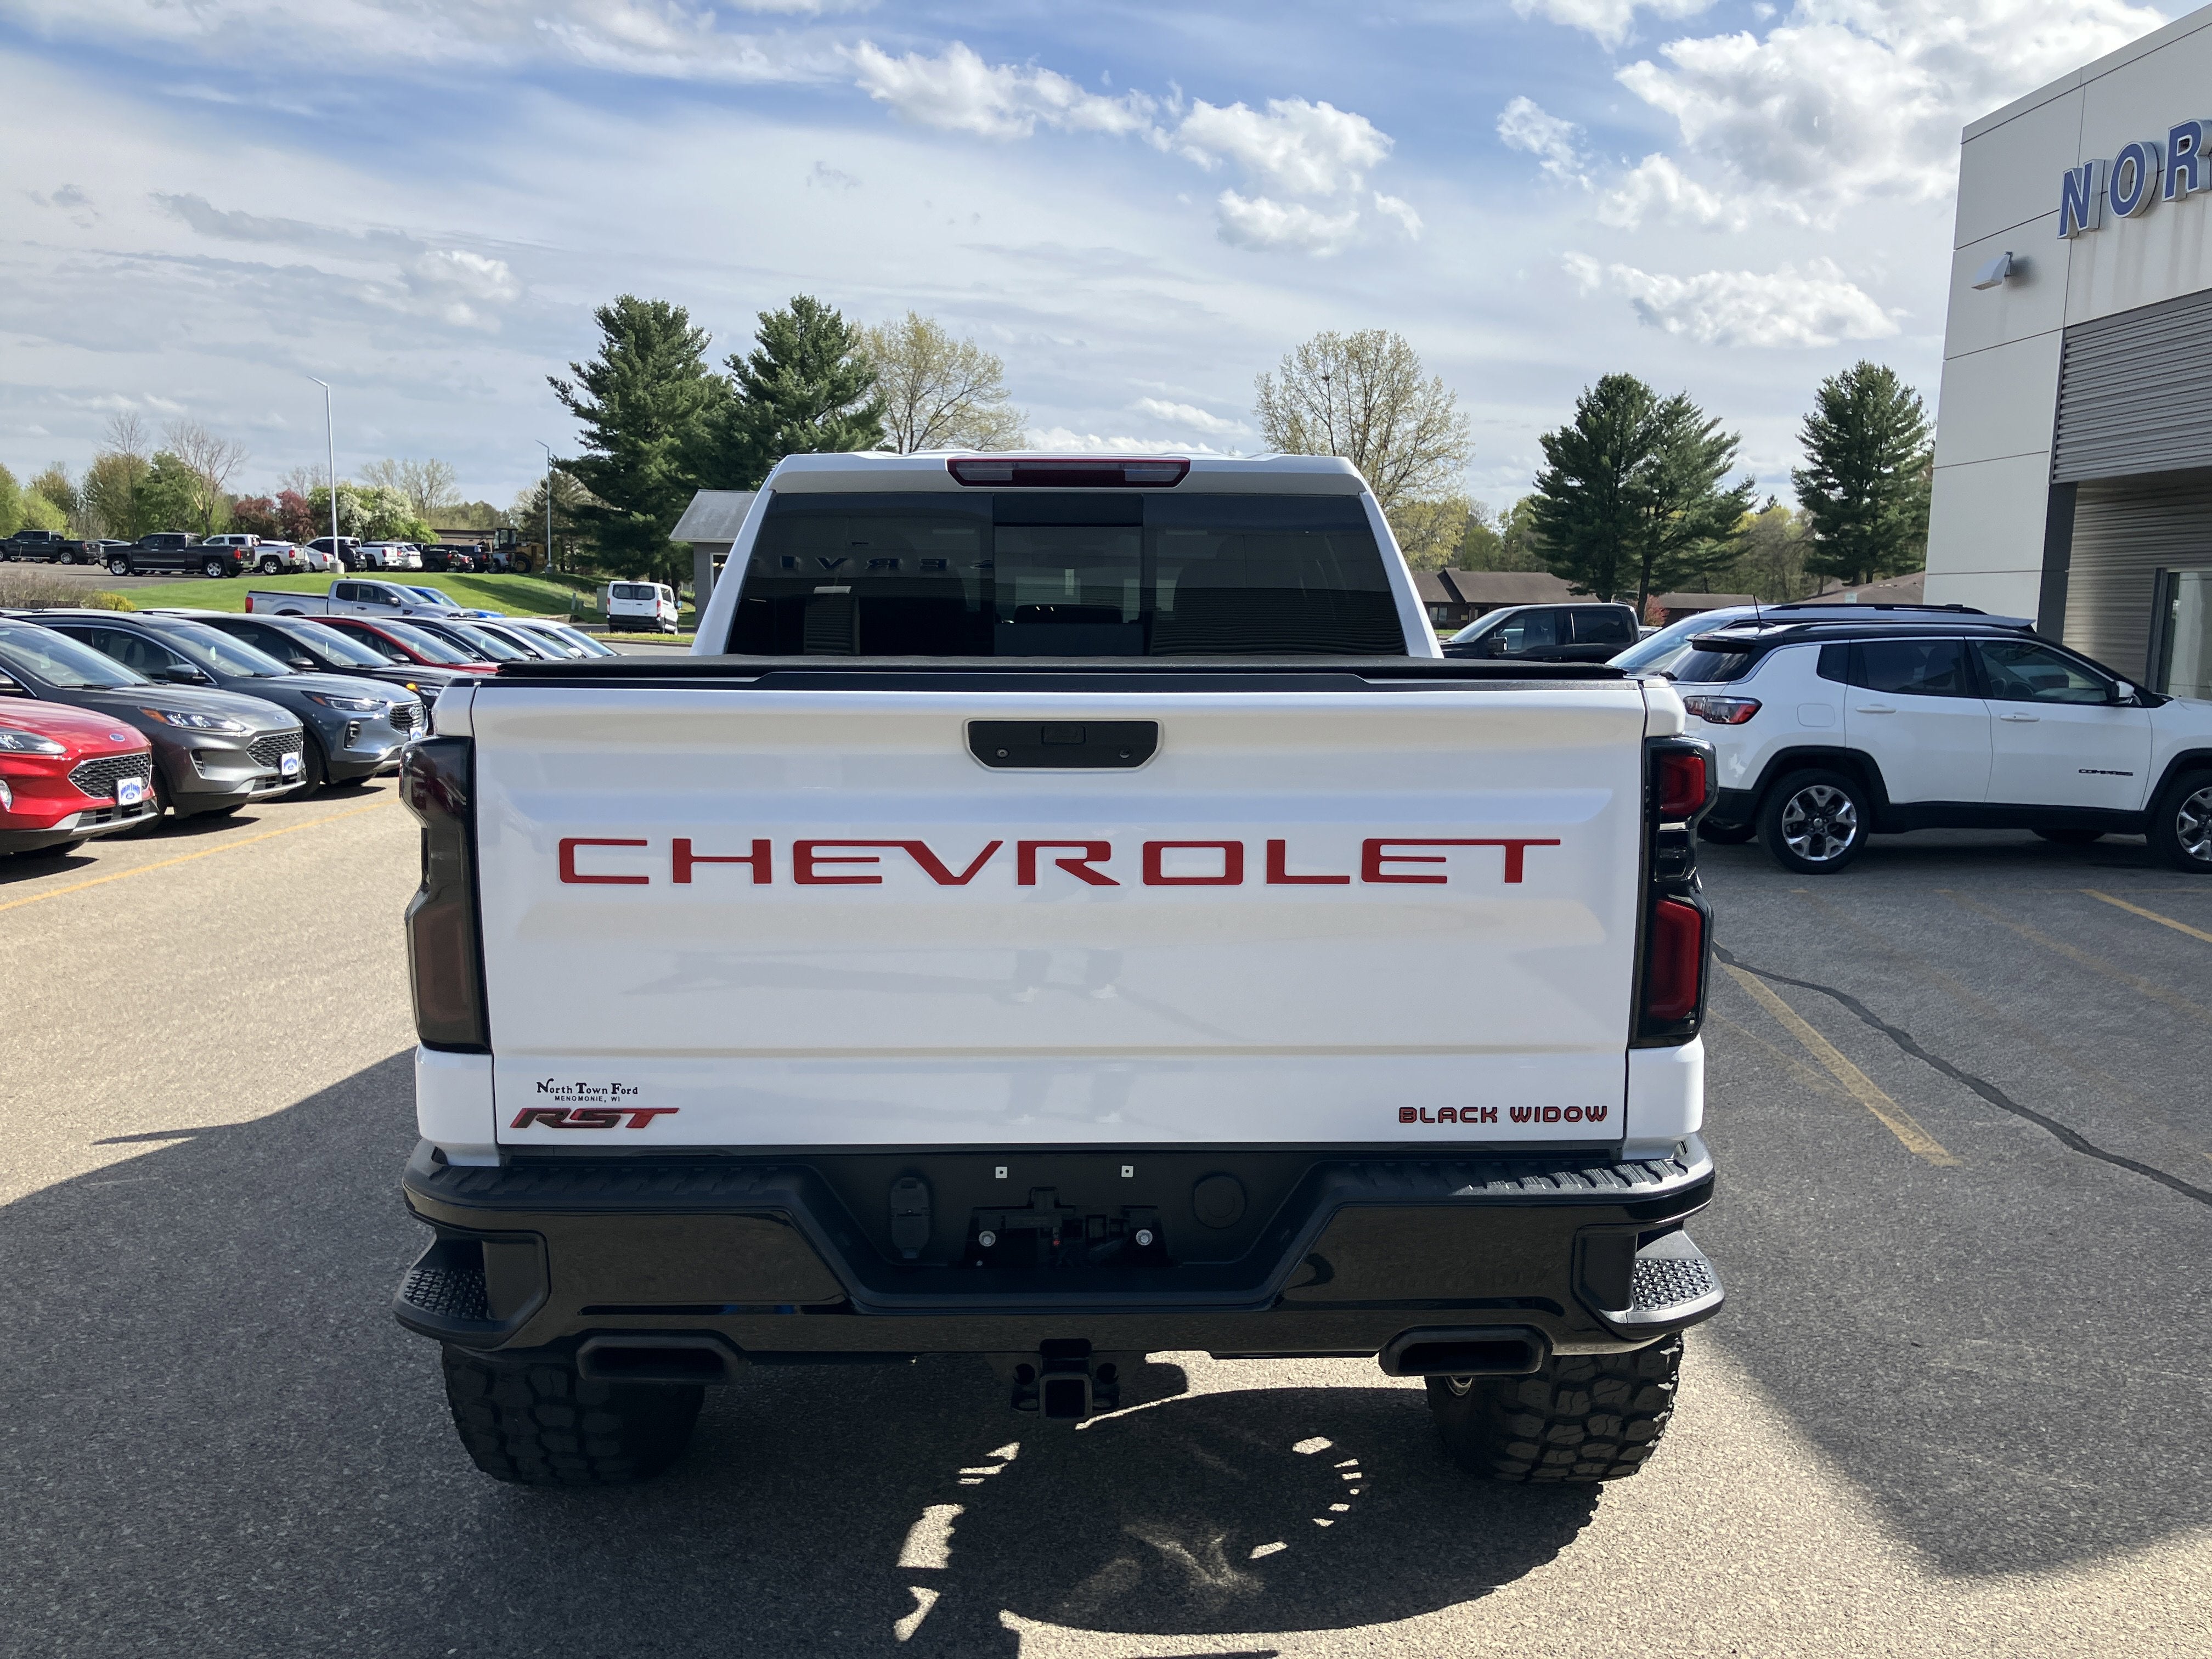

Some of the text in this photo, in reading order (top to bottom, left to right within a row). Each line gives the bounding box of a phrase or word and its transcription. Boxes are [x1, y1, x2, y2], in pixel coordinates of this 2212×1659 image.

[558, 838, 1561, 886] CHEVROLET
[536, 1078, 638, 1095] North Town Ford
[510, 1108, 680, 1128] RST
[1398, 1105, 1608, 1123] BLACK WIDOW
